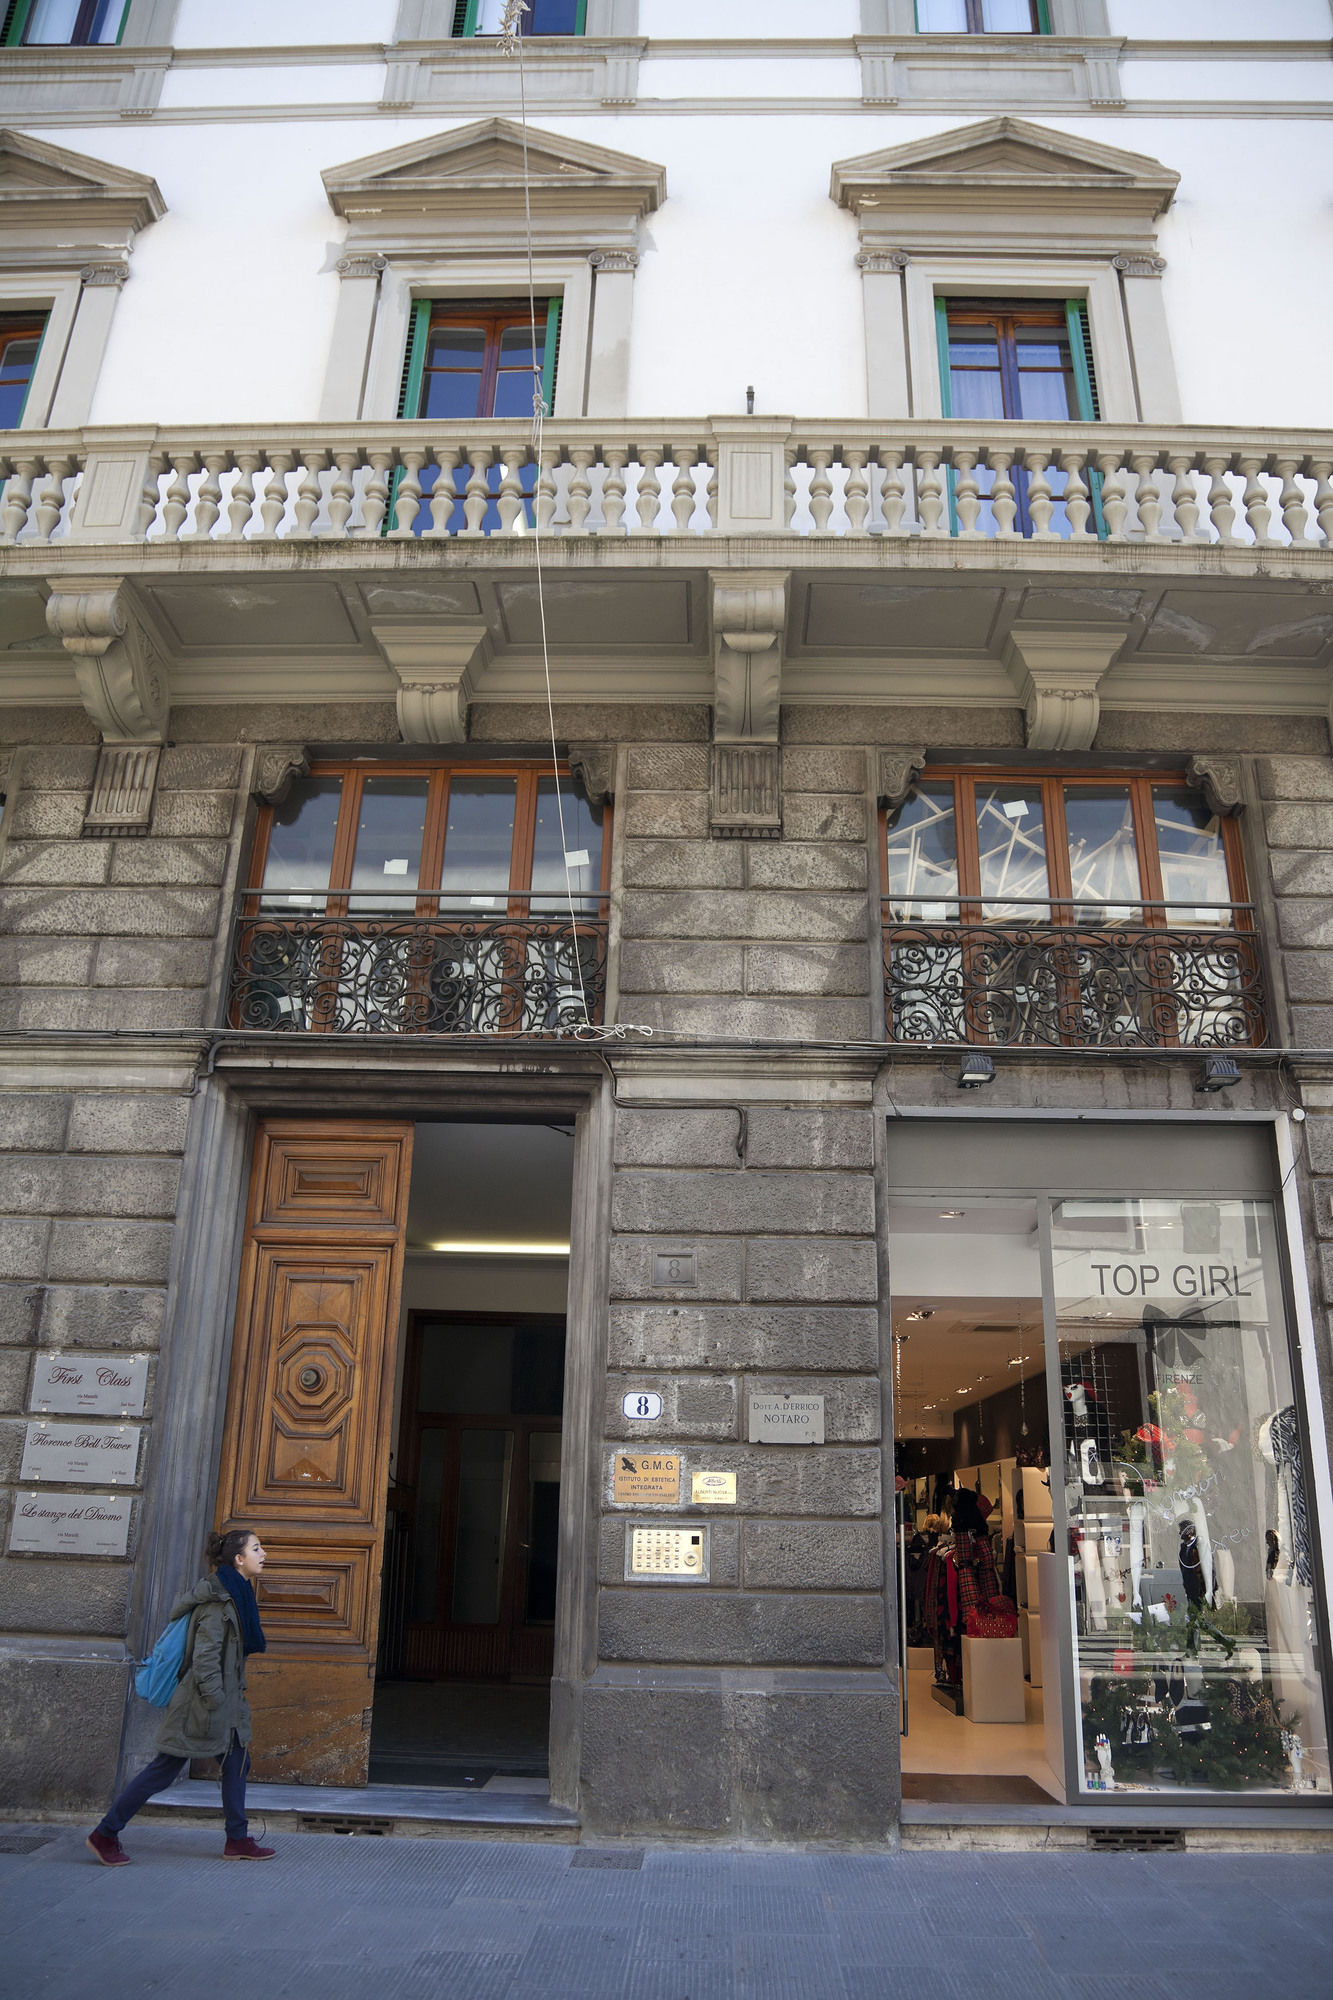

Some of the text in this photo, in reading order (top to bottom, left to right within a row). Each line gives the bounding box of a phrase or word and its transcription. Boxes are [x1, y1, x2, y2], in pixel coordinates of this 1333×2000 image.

[668, 1259, 681, 1279] 8
[1091, 1264, 1252, 1297] TOP GIRL
[48, 1366, 132, 1387] First Class
[636, 1395, 649, 1416] 8
[783, 1402, 820, 1411] D'ERRICO
[764, 1414, 810, 1424] NOTARO
[30, 1432, 132, 1450] Florence Bell Tower
[641, 1460, 676, 1471] G.M.G.
[20, 1503, 122, 1524] Le stanze del Duomo
